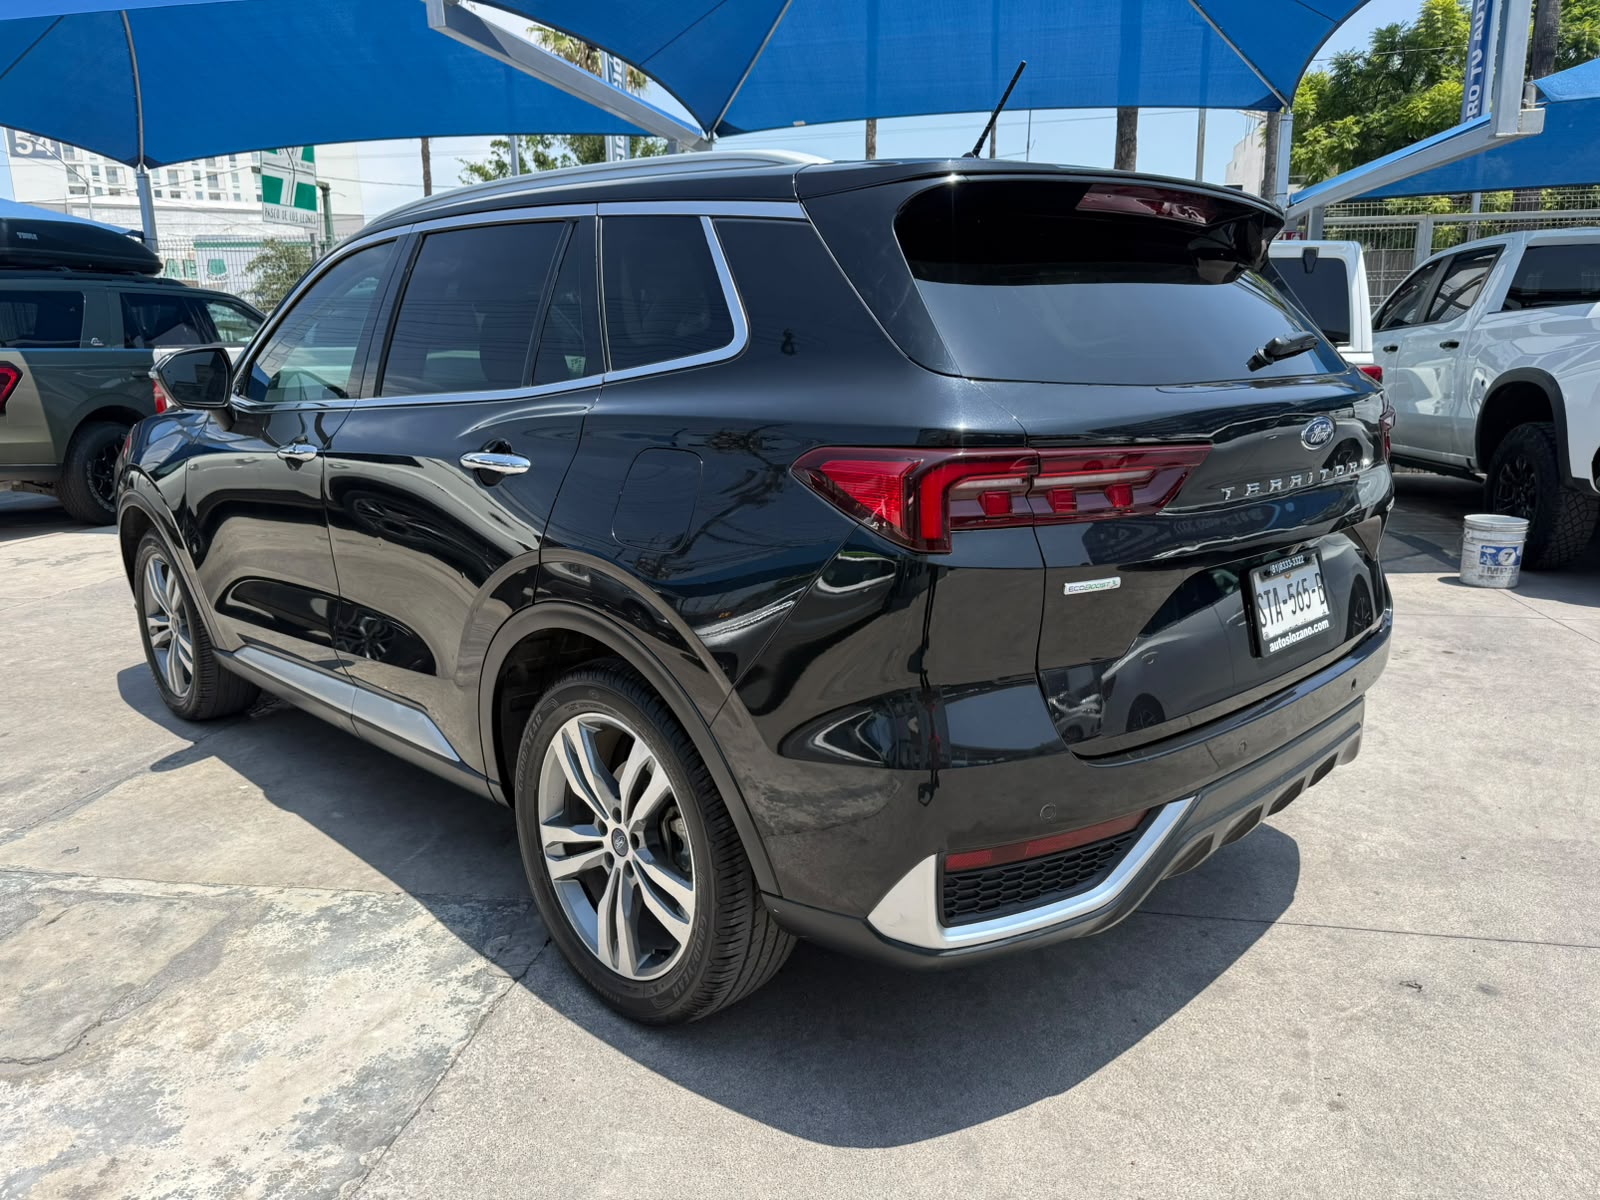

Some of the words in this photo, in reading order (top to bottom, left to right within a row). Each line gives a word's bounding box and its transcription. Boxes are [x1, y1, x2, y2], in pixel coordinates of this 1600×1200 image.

[1471, 49, 1483, 80] TU
[1466, 85, 1480, 122] RO
[15, 130, 55, 156] 54
[1504, 552, 1514, 562] 7
[1269, 619, 1329, 653] autoslozano.com
